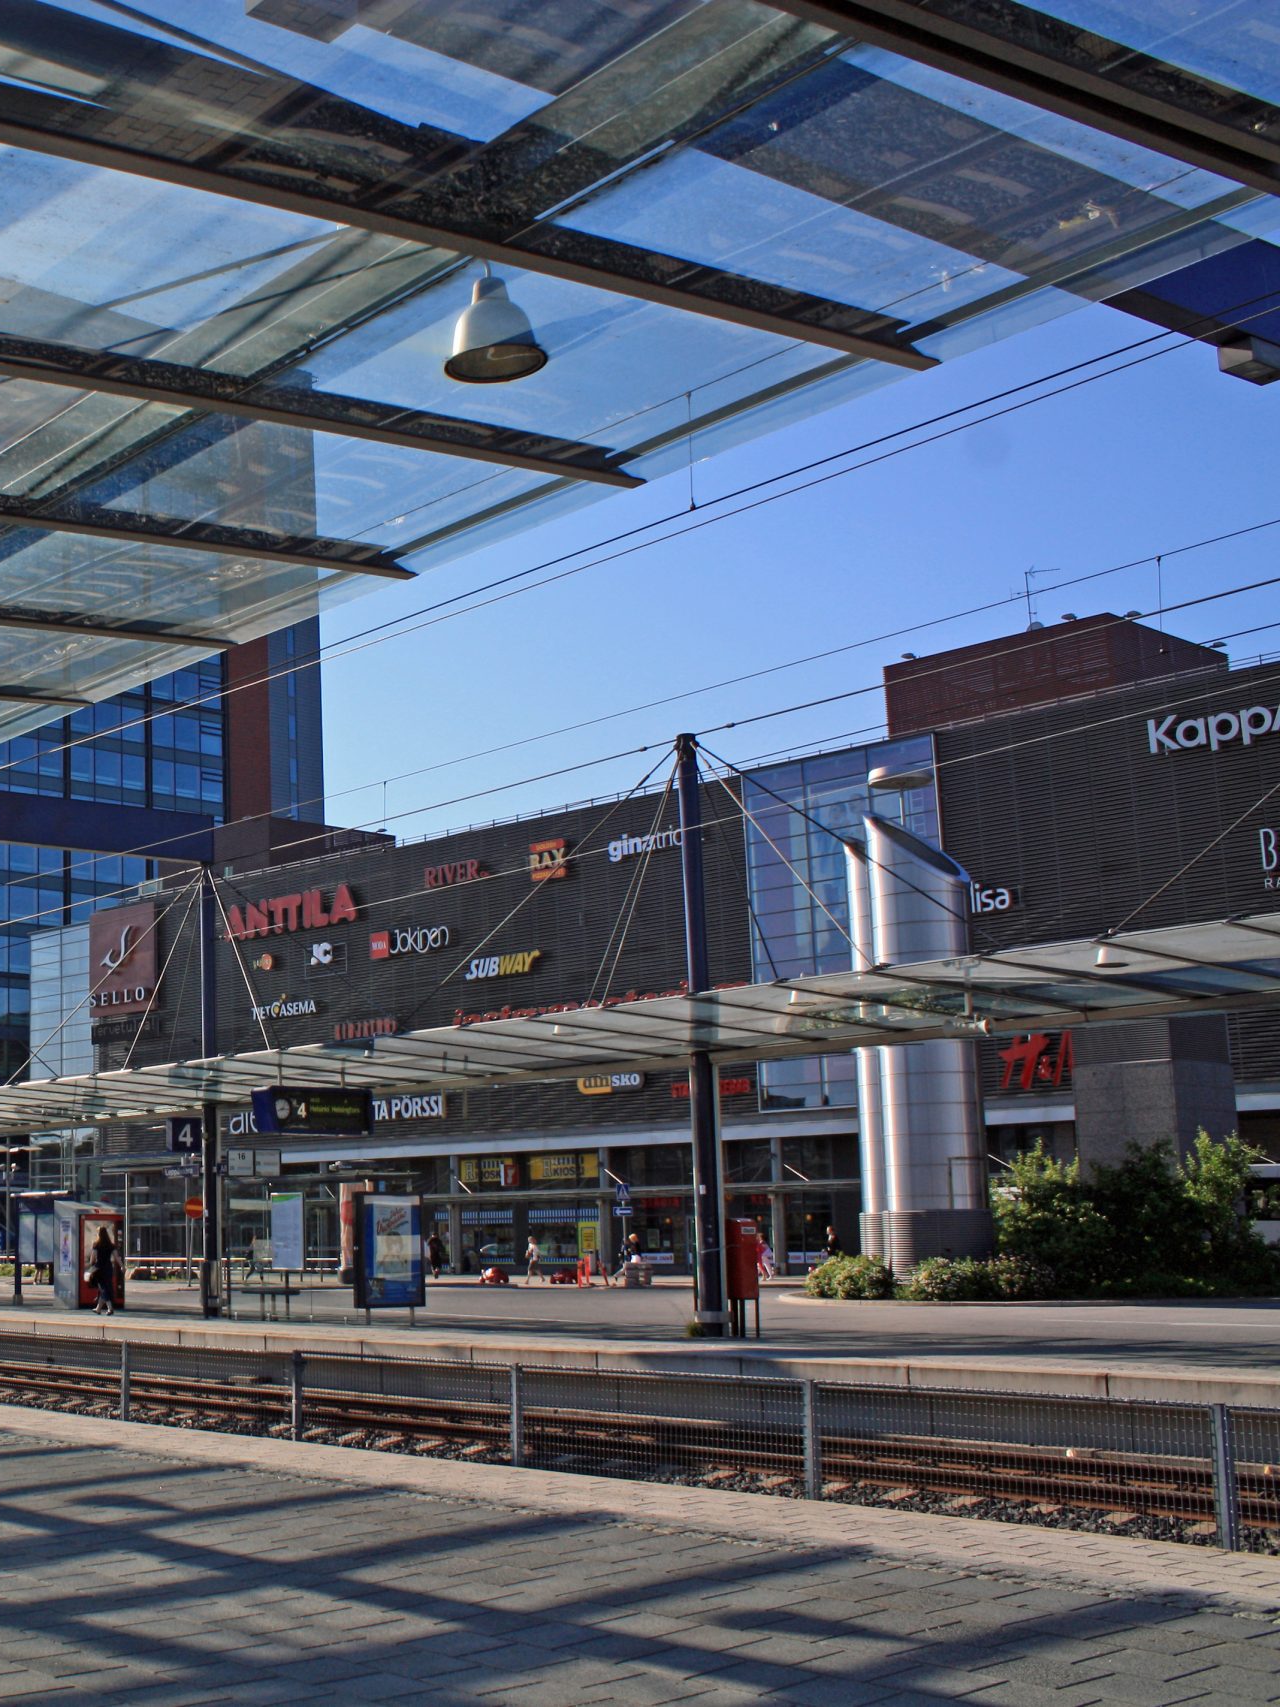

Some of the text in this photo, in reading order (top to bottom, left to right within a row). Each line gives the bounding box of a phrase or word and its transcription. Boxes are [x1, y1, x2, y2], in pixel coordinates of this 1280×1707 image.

[1147, 704, 1280, 754] Kapp
[424, 859, 480, 889] RIVER
[224, 883, 358, 943] ANTTILA
[390, 925, 449, 954] Jokinen
[465, 950, 542, 981] SUBWAY
[90, 986, 145, 1008] SELLO
[296, 1103, 307, 1118] 4
[391, 1095, 443, 1119] PÖRSSI
[178, 1123, 194, 1148] 4
